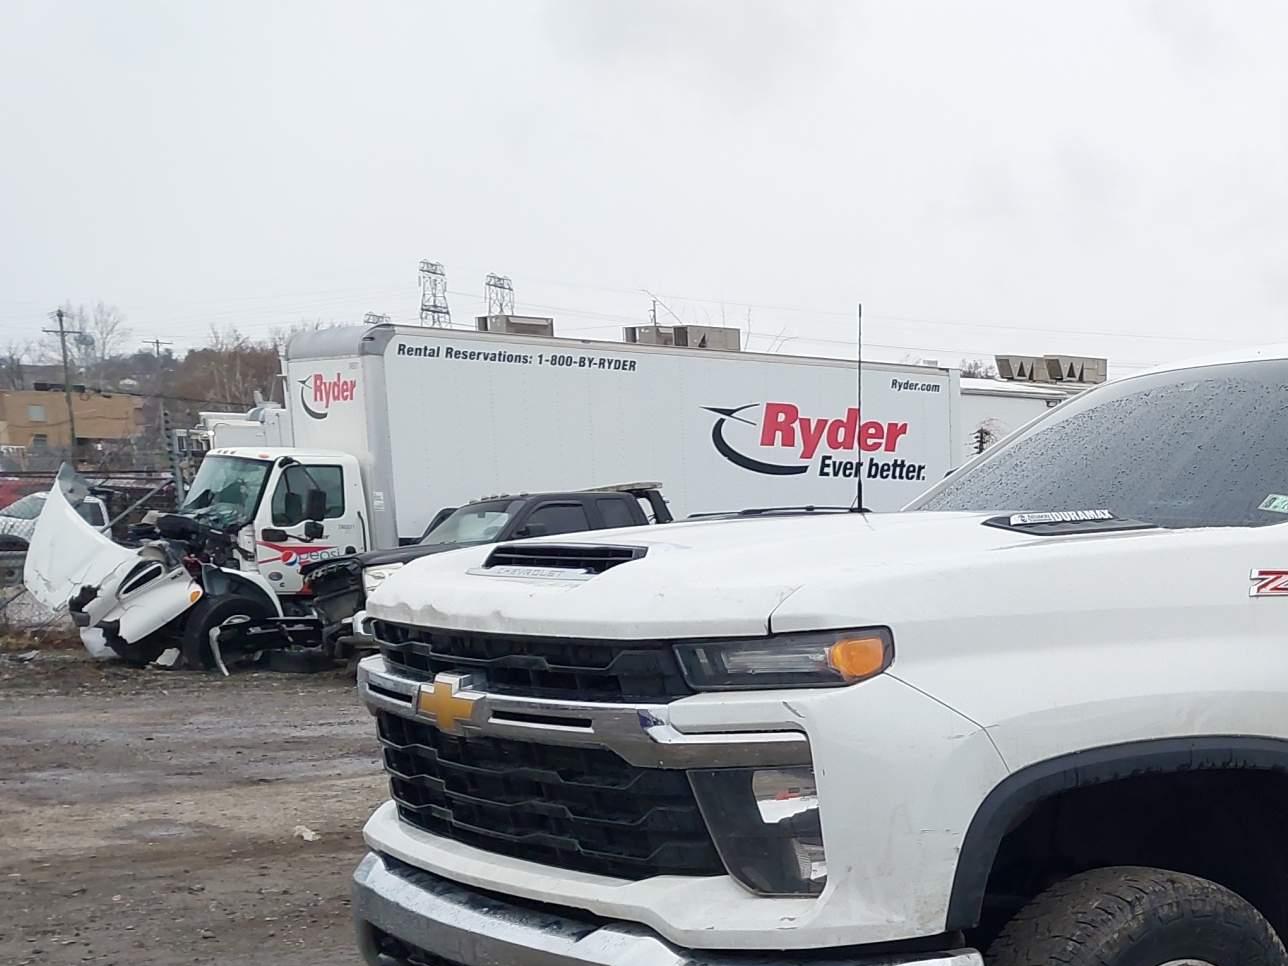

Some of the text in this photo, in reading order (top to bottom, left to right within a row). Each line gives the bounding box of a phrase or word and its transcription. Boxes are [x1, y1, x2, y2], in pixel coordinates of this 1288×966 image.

[397, 343, 637, 372] Rental Reservations: 1-800-BY-RYDER
[313, 372, 356, 408] Ryder
[891, 379, 940, 392] Ryder.com
[760, 402, 908, 460] Ryder
[819, 455, 926, 481] Ever better.
[1052, 509, 1114, 522] DURAMAX
